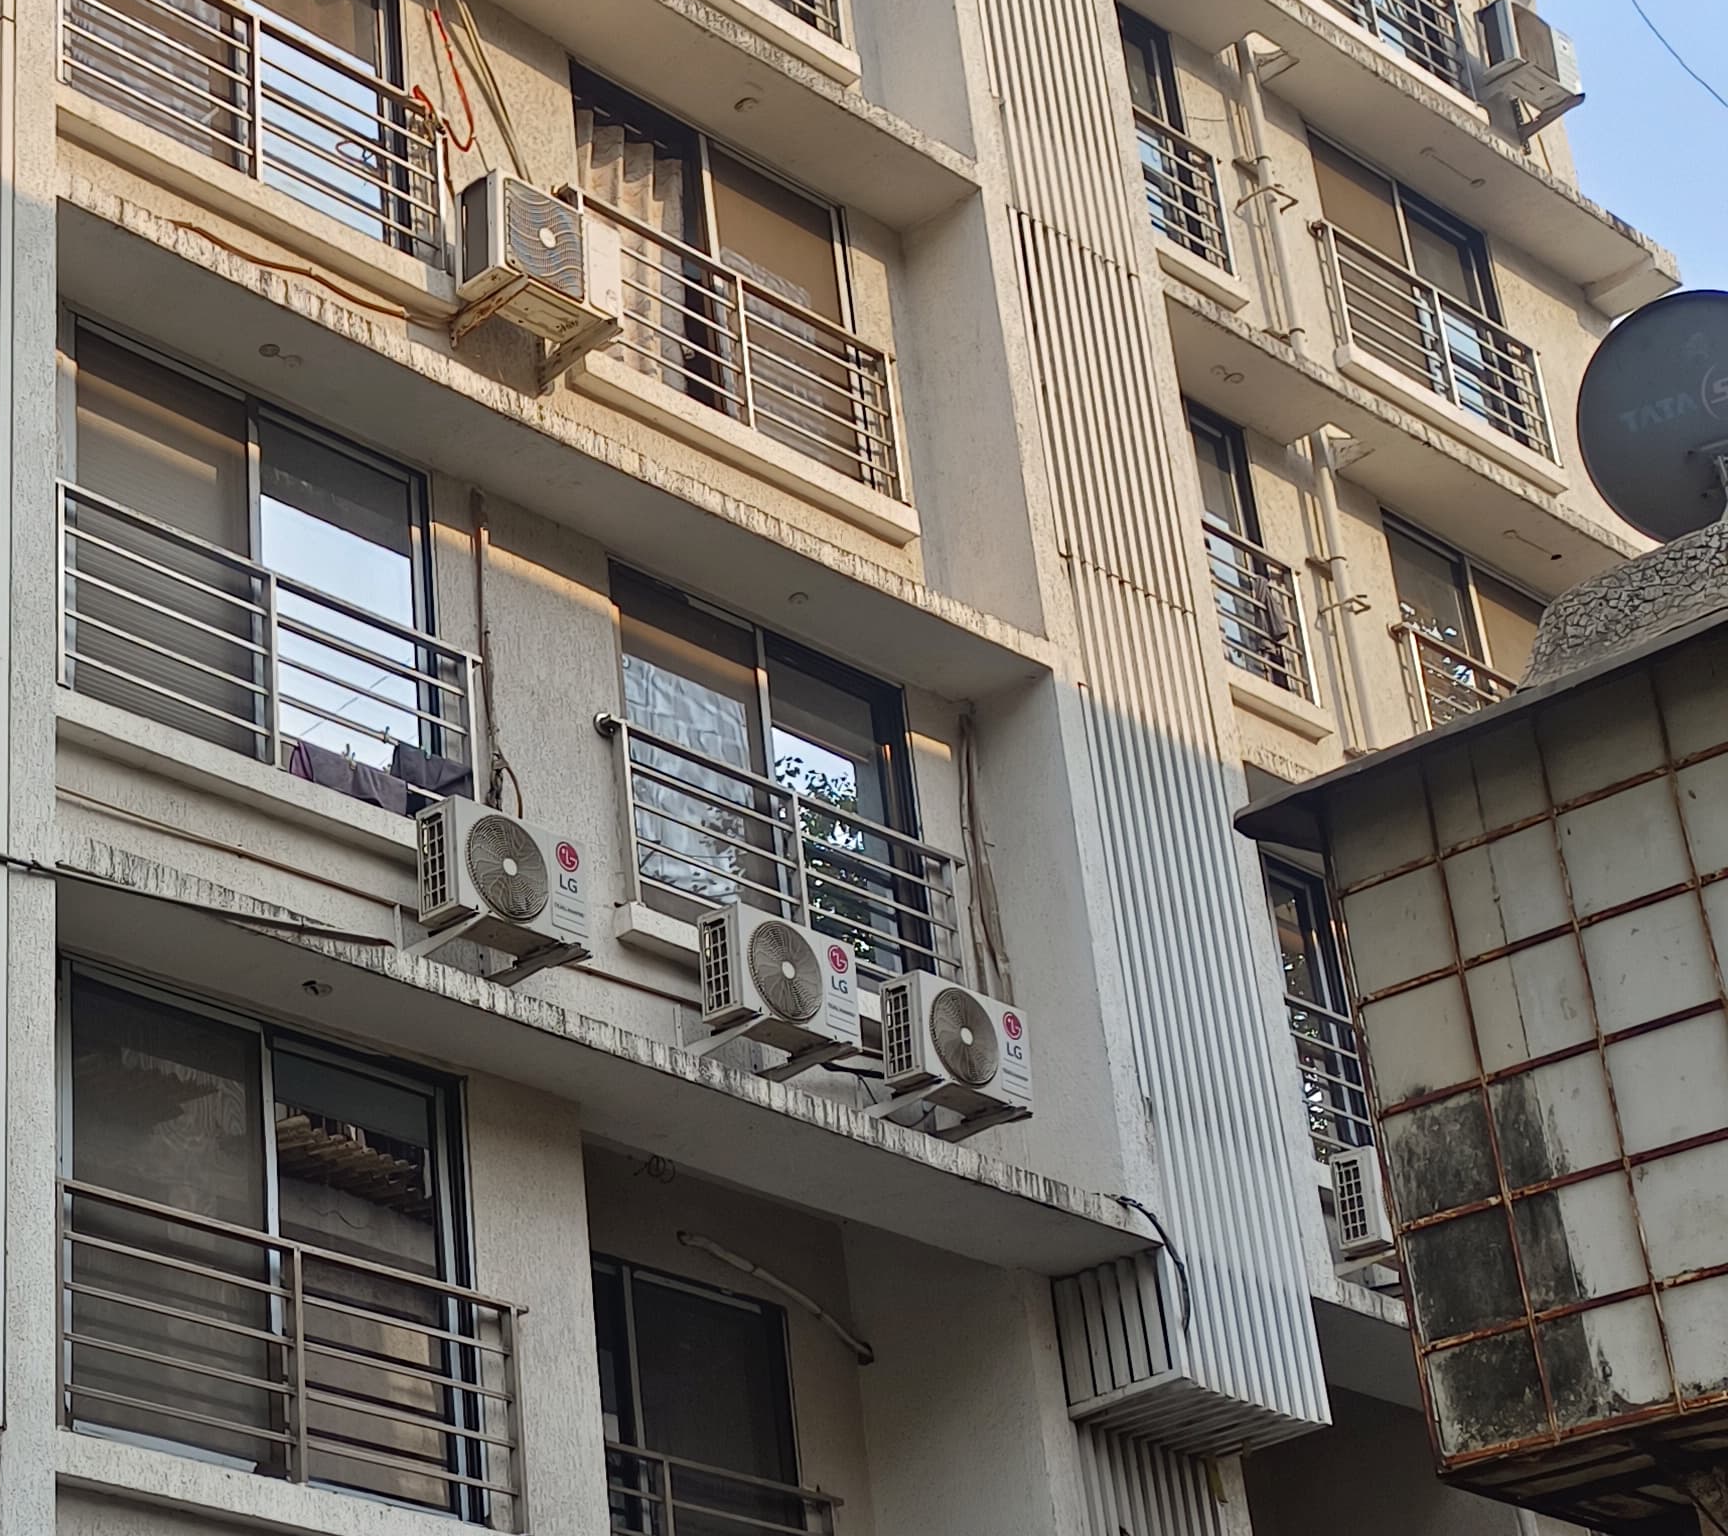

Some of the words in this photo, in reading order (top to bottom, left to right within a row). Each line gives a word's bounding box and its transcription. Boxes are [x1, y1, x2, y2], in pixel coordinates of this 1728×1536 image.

[1618, 391, 1697, 433] TATA
[559, 872, 578, 895] LG
[831, 975, 849, 995] LG
[1006, 1040, 1023, 1061] LG
